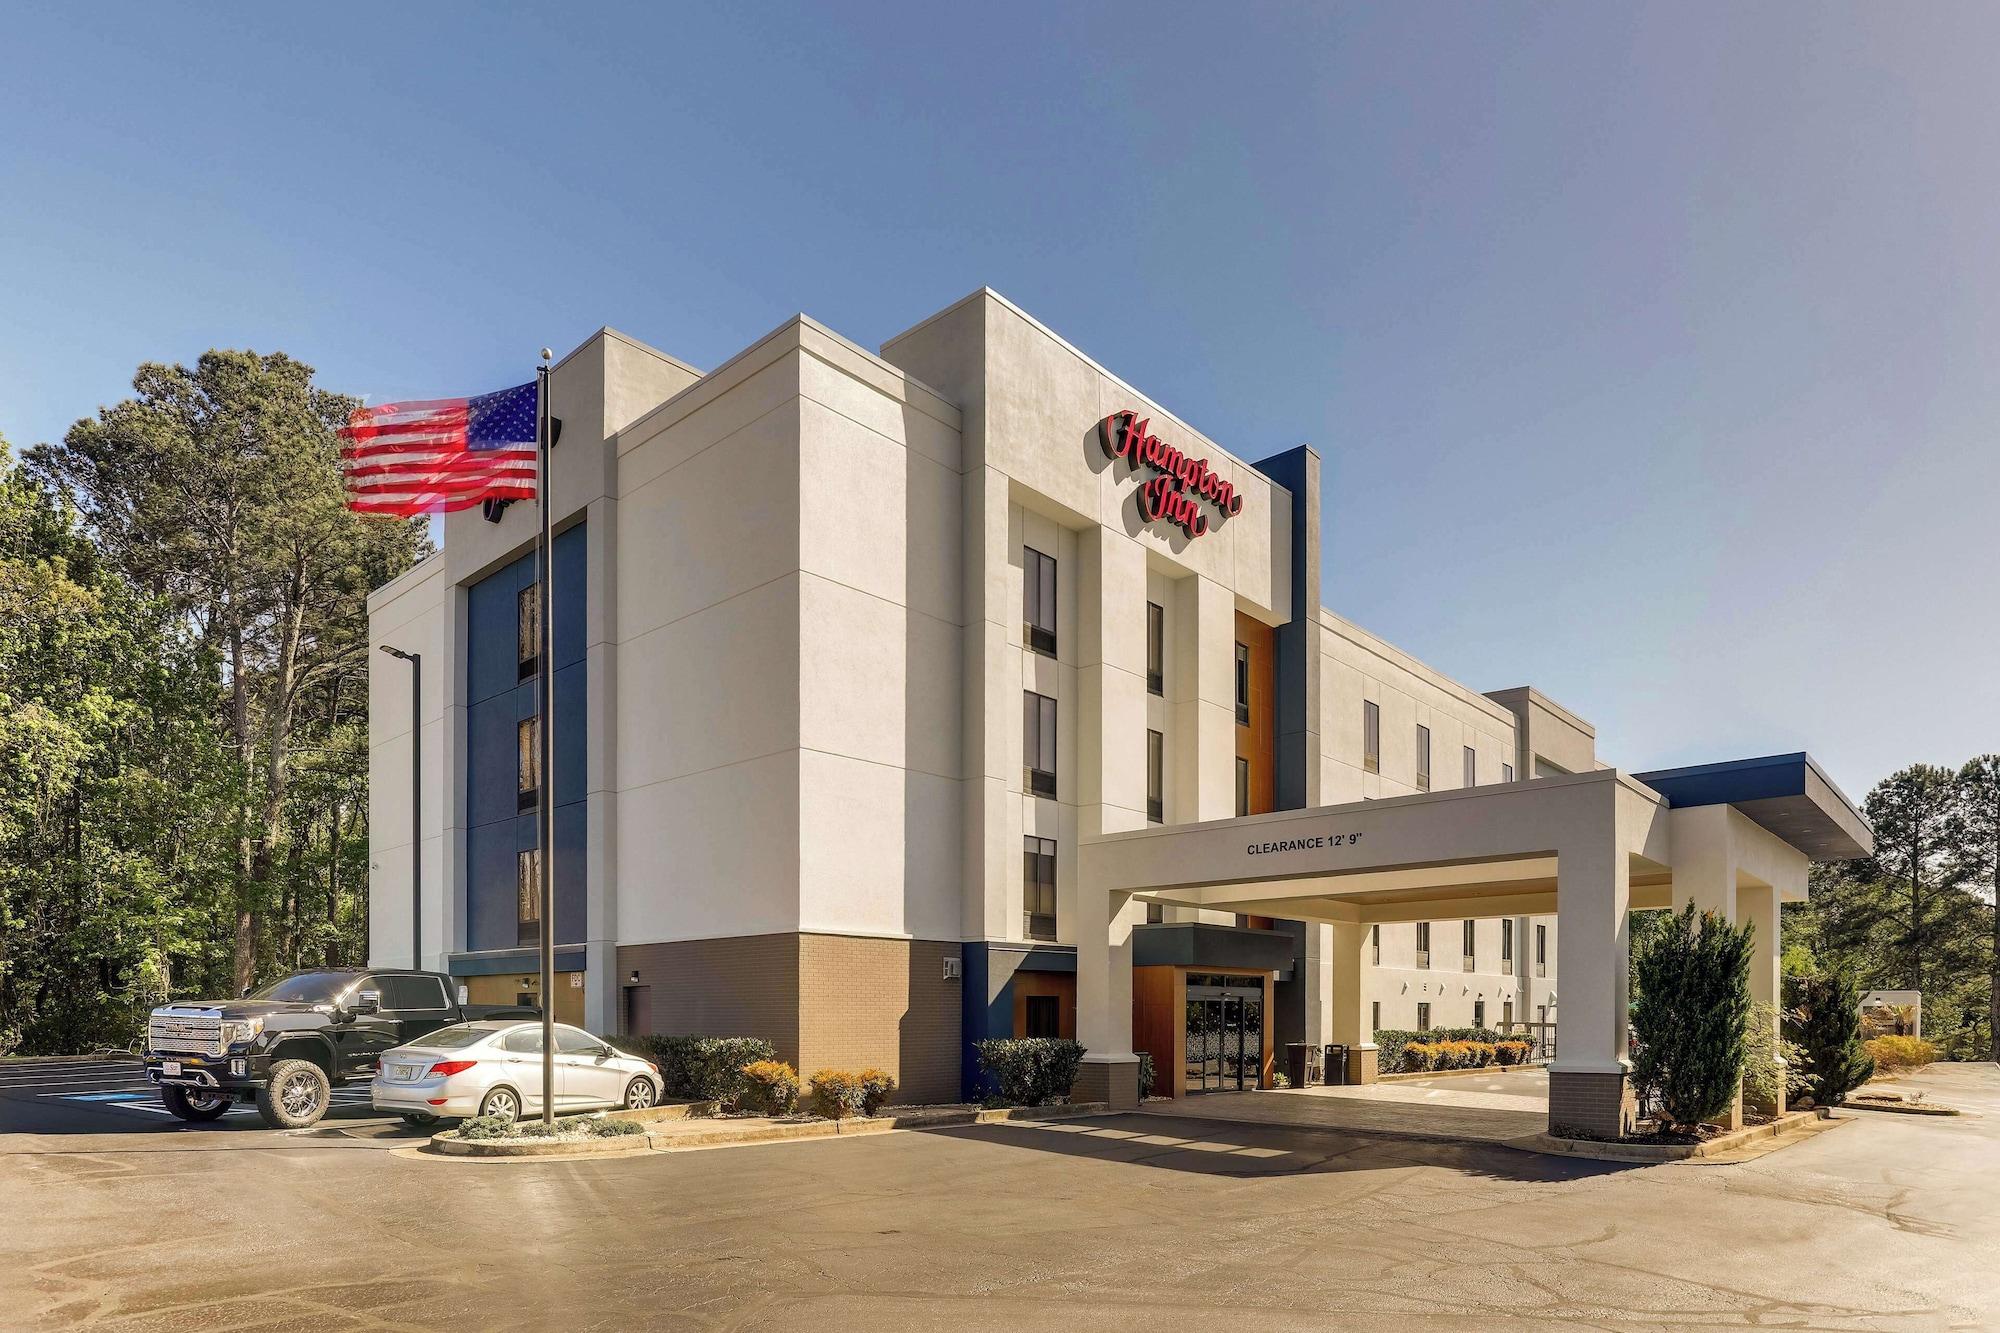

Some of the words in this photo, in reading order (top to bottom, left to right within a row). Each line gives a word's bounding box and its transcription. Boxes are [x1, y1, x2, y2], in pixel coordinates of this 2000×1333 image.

[1101, 410, 1243, 516] Hampton
[1139, 474, 1209, 537] Inn
[1247, 837, 1323, 855] CLEARANCE
[1327, 835, 1345, 846] 12'
